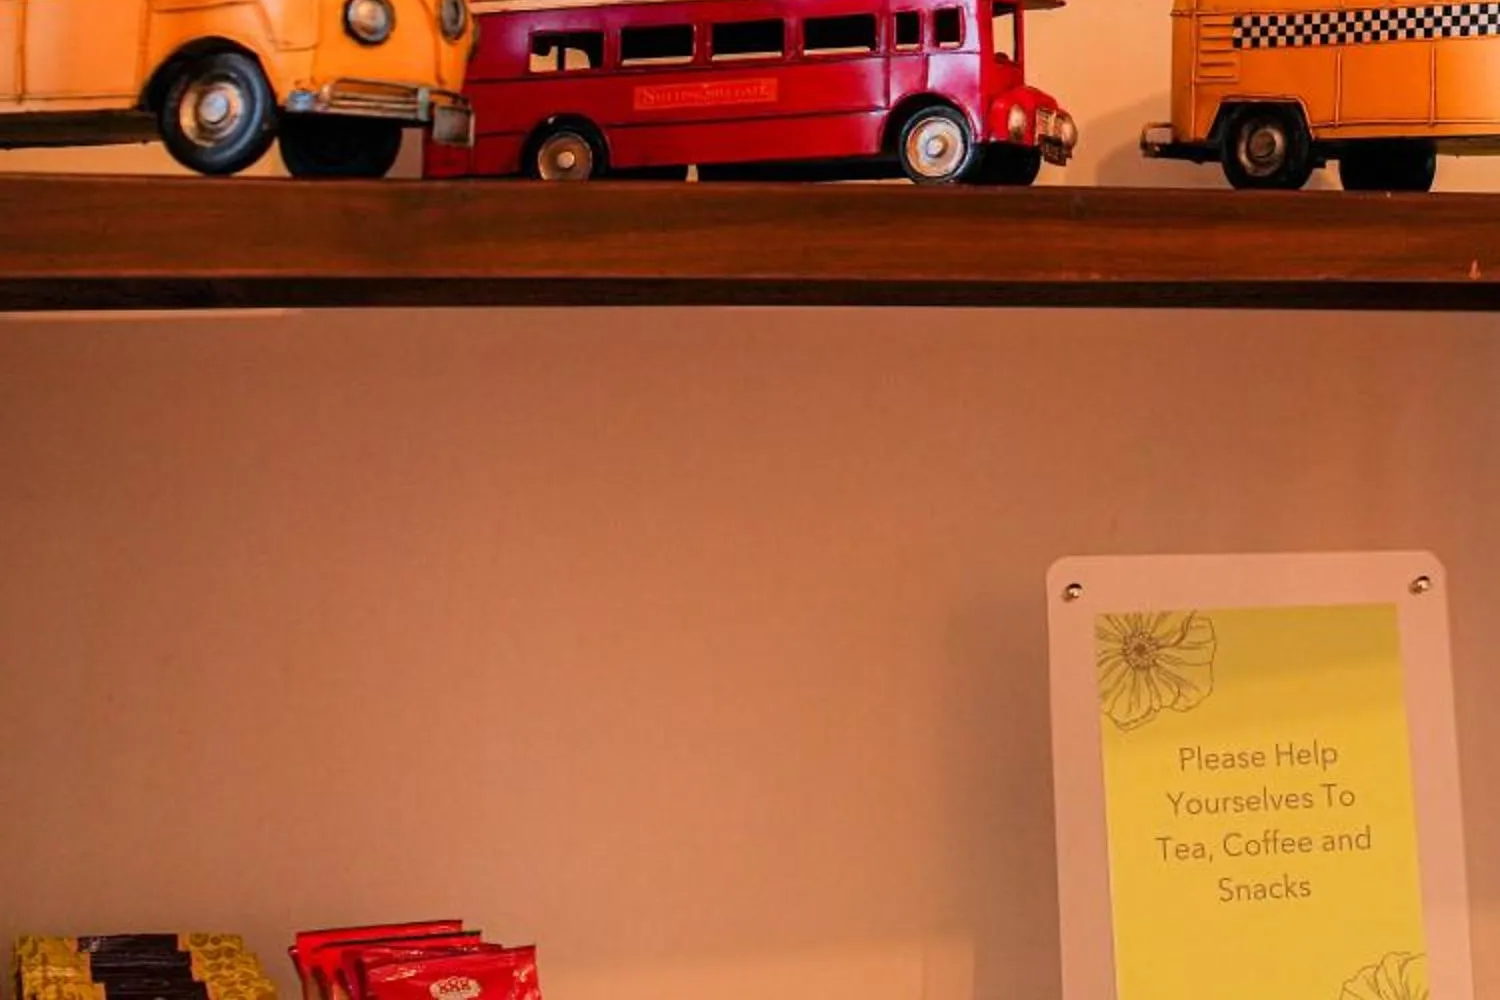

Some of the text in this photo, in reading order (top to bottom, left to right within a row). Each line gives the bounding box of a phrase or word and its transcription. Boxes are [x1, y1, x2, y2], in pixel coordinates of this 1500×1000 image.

[1178, 739, 1339, 772] Please Help
[1166, 783, 1357, 817] Yourselves To
[1154, 826, 1372, 863] Tea, Coffee and
[1218, 874, 1312, 903] Snacks
